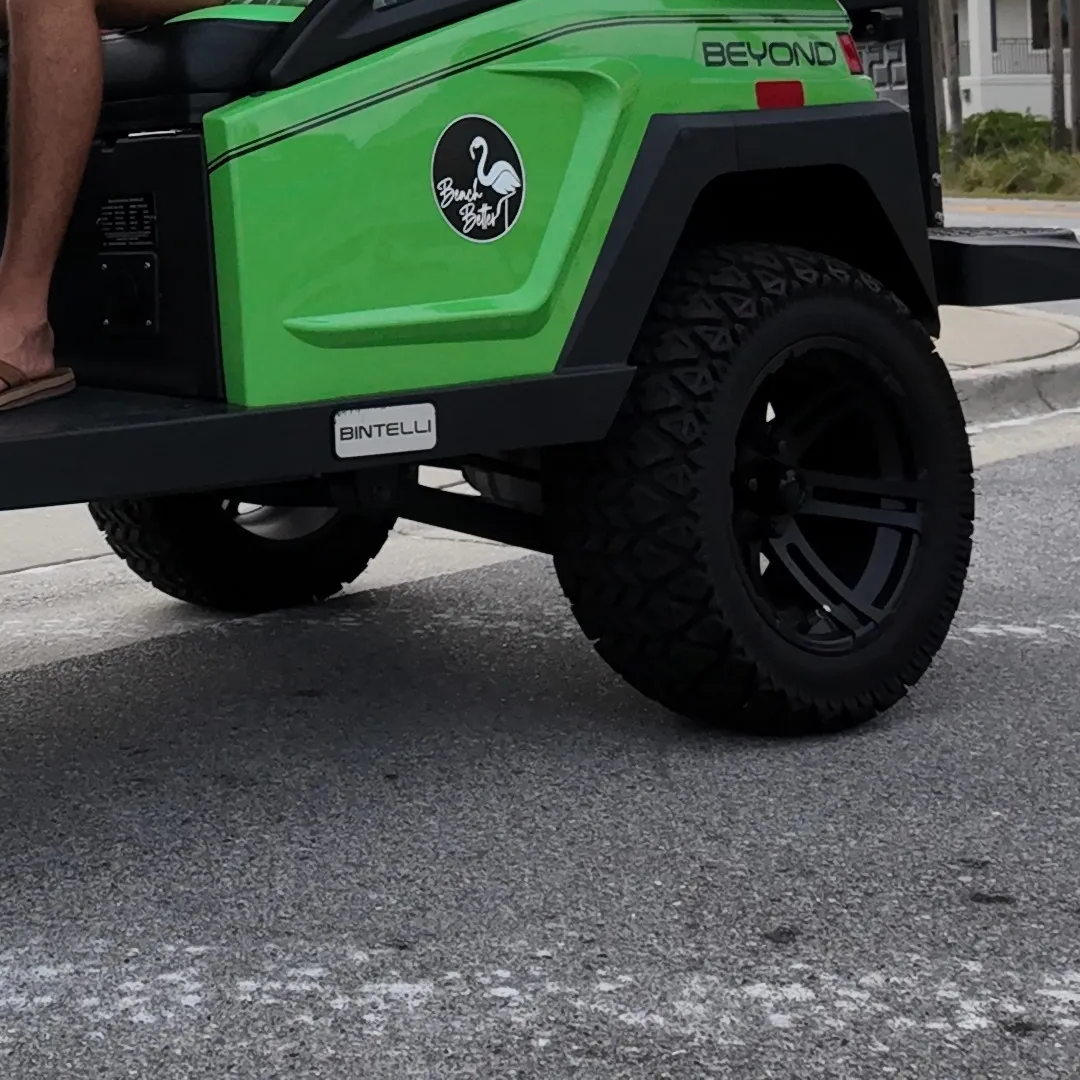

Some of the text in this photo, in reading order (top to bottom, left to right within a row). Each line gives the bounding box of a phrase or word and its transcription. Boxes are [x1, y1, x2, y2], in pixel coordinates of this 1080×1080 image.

[702, 41, 836, 67] BEYOND
[436, 176, 483, 209] Beach
[459, 202, 500, 234] Better
[340, 419, 432, 441] BINTELLI
